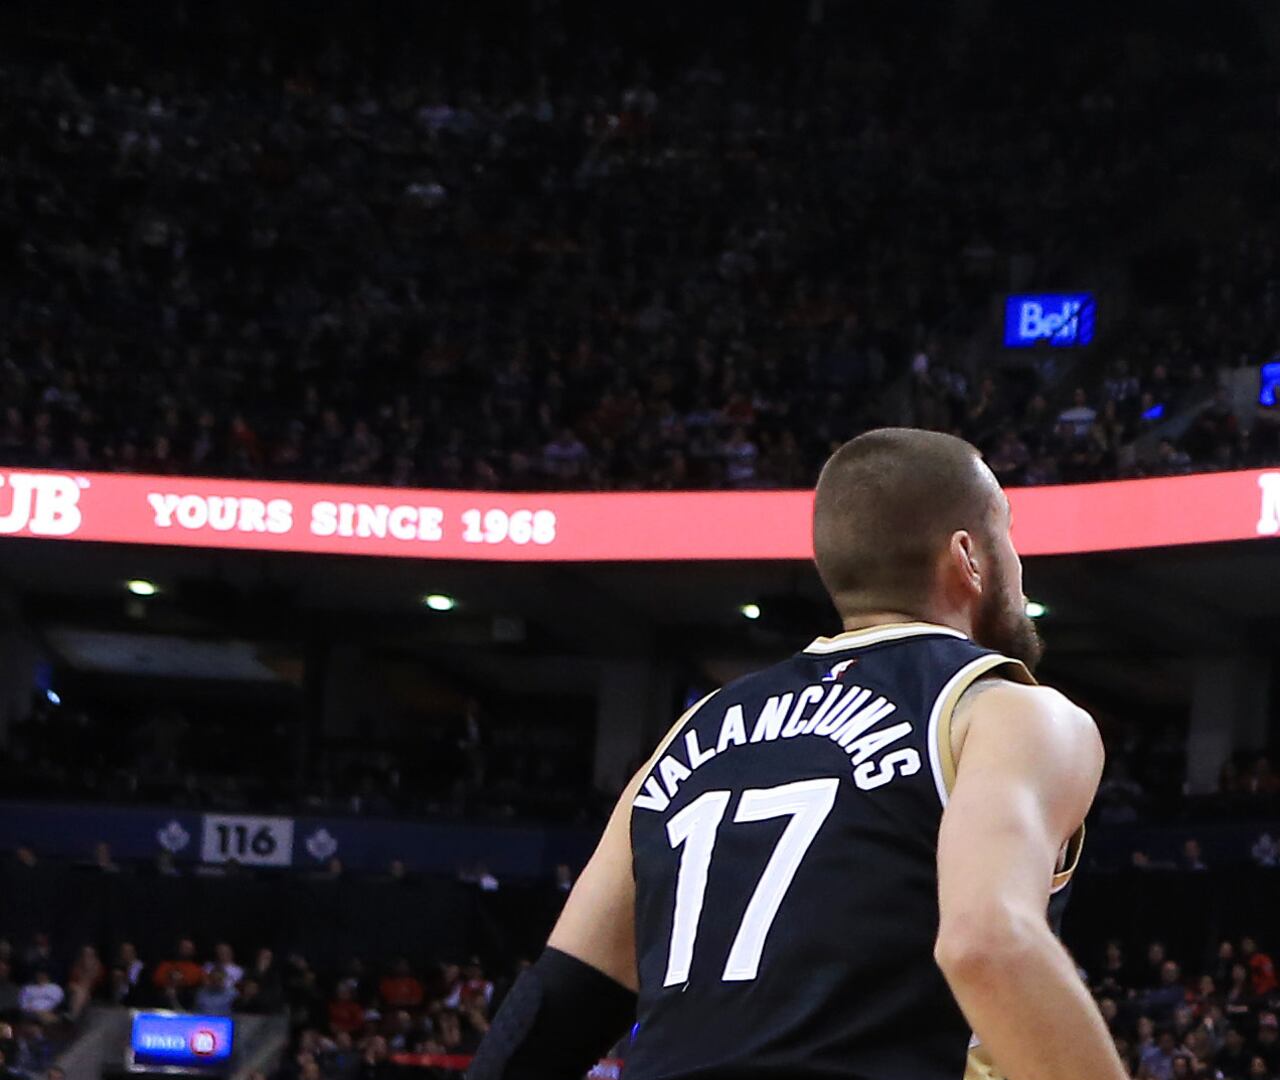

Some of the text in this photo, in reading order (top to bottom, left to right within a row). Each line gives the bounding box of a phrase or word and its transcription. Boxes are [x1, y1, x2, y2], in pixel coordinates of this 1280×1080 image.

[148, 493, 293, 534] YOURS
[310, 501, 444, 541] SINCE
[461, 508, 556, 545] 1968
[632, 684, 921, 811] VALANCIUNAS
[216, 824, 277, 857] 116
[663, 778, 840, 987] 17
